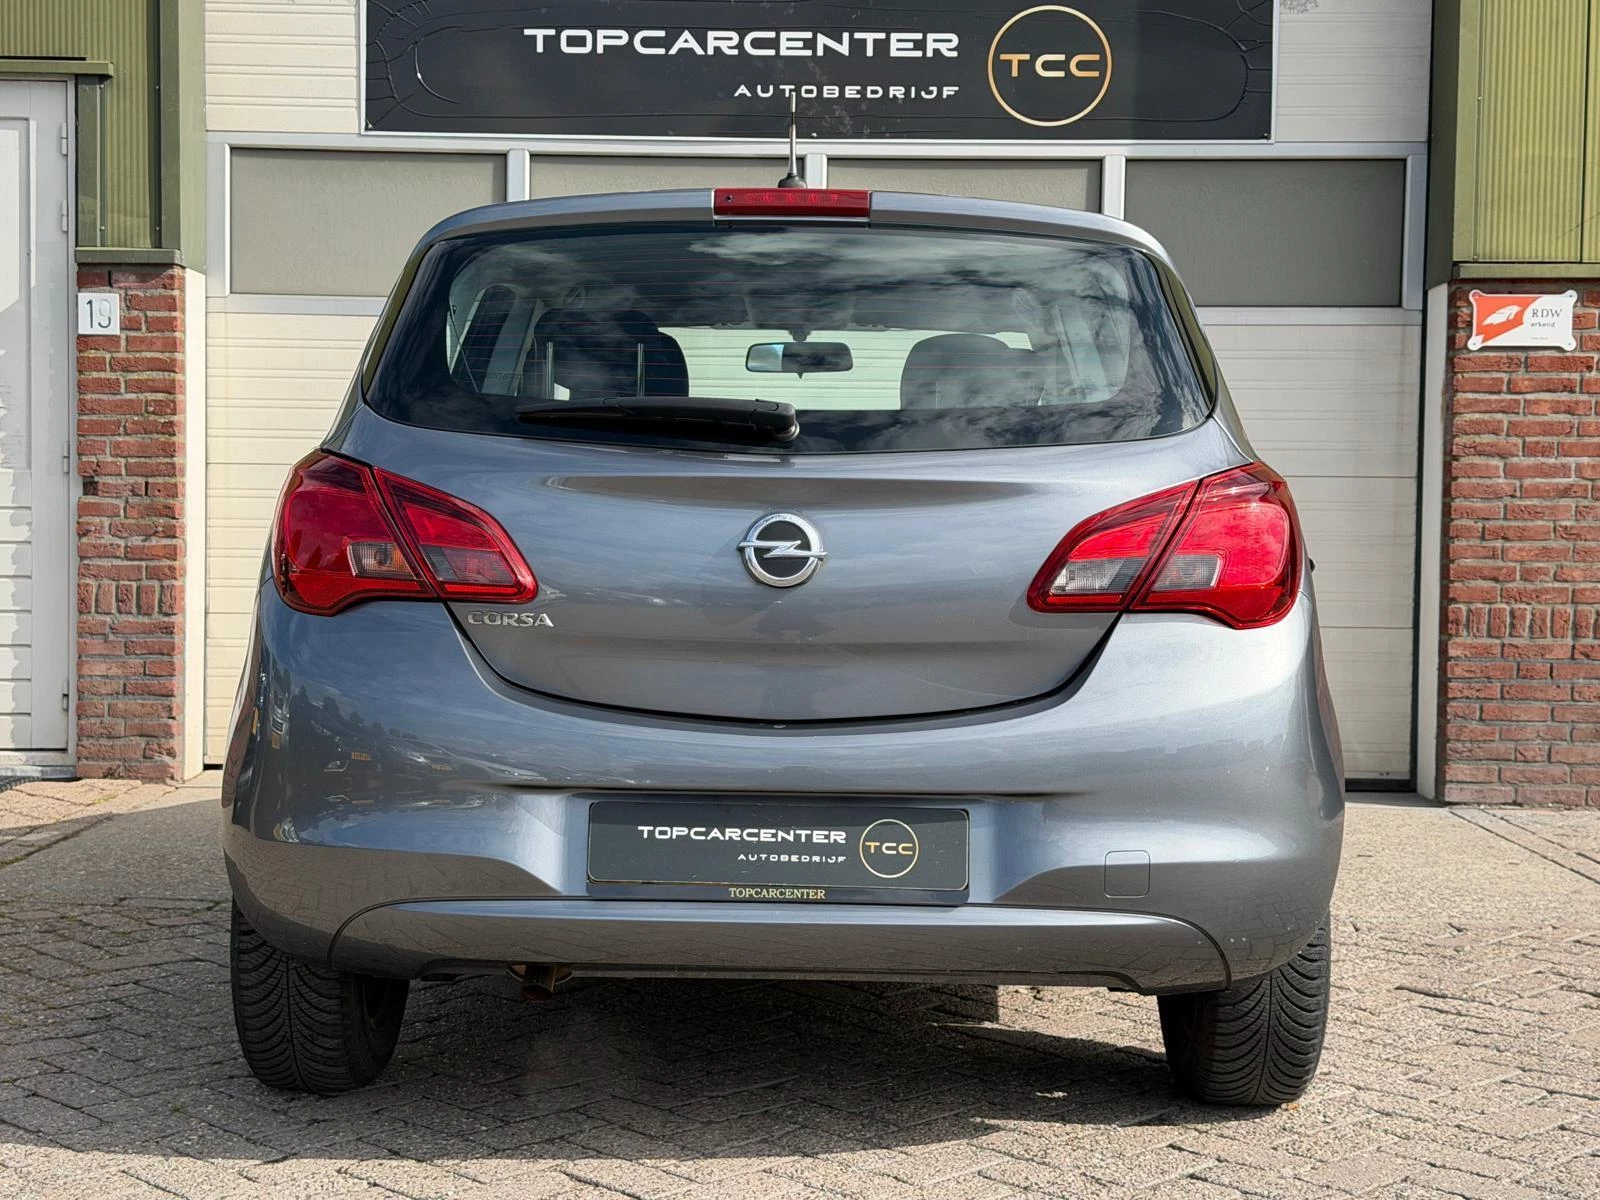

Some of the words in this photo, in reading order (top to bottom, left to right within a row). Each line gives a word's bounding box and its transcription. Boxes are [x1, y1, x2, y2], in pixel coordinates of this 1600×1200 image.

[523, 28, 959, 58] TOPCARCENTER
[1000, 53, 1100, 78] TCC
[733, 84, 959, 99] AUTOBEDRIJF
[86, 298, 112, 329] 19
[1531, 308, 1563, 318] RDW
[467, 611, 554, 628] CORSA
[637, 825, 847, 844] TOPCARCENTER
[864, 841, 913, 855] TCC
[737, 854, 847, 864] AUTOBEDRIJF
[728, 887, 826, 900] TOPCARCENTER
